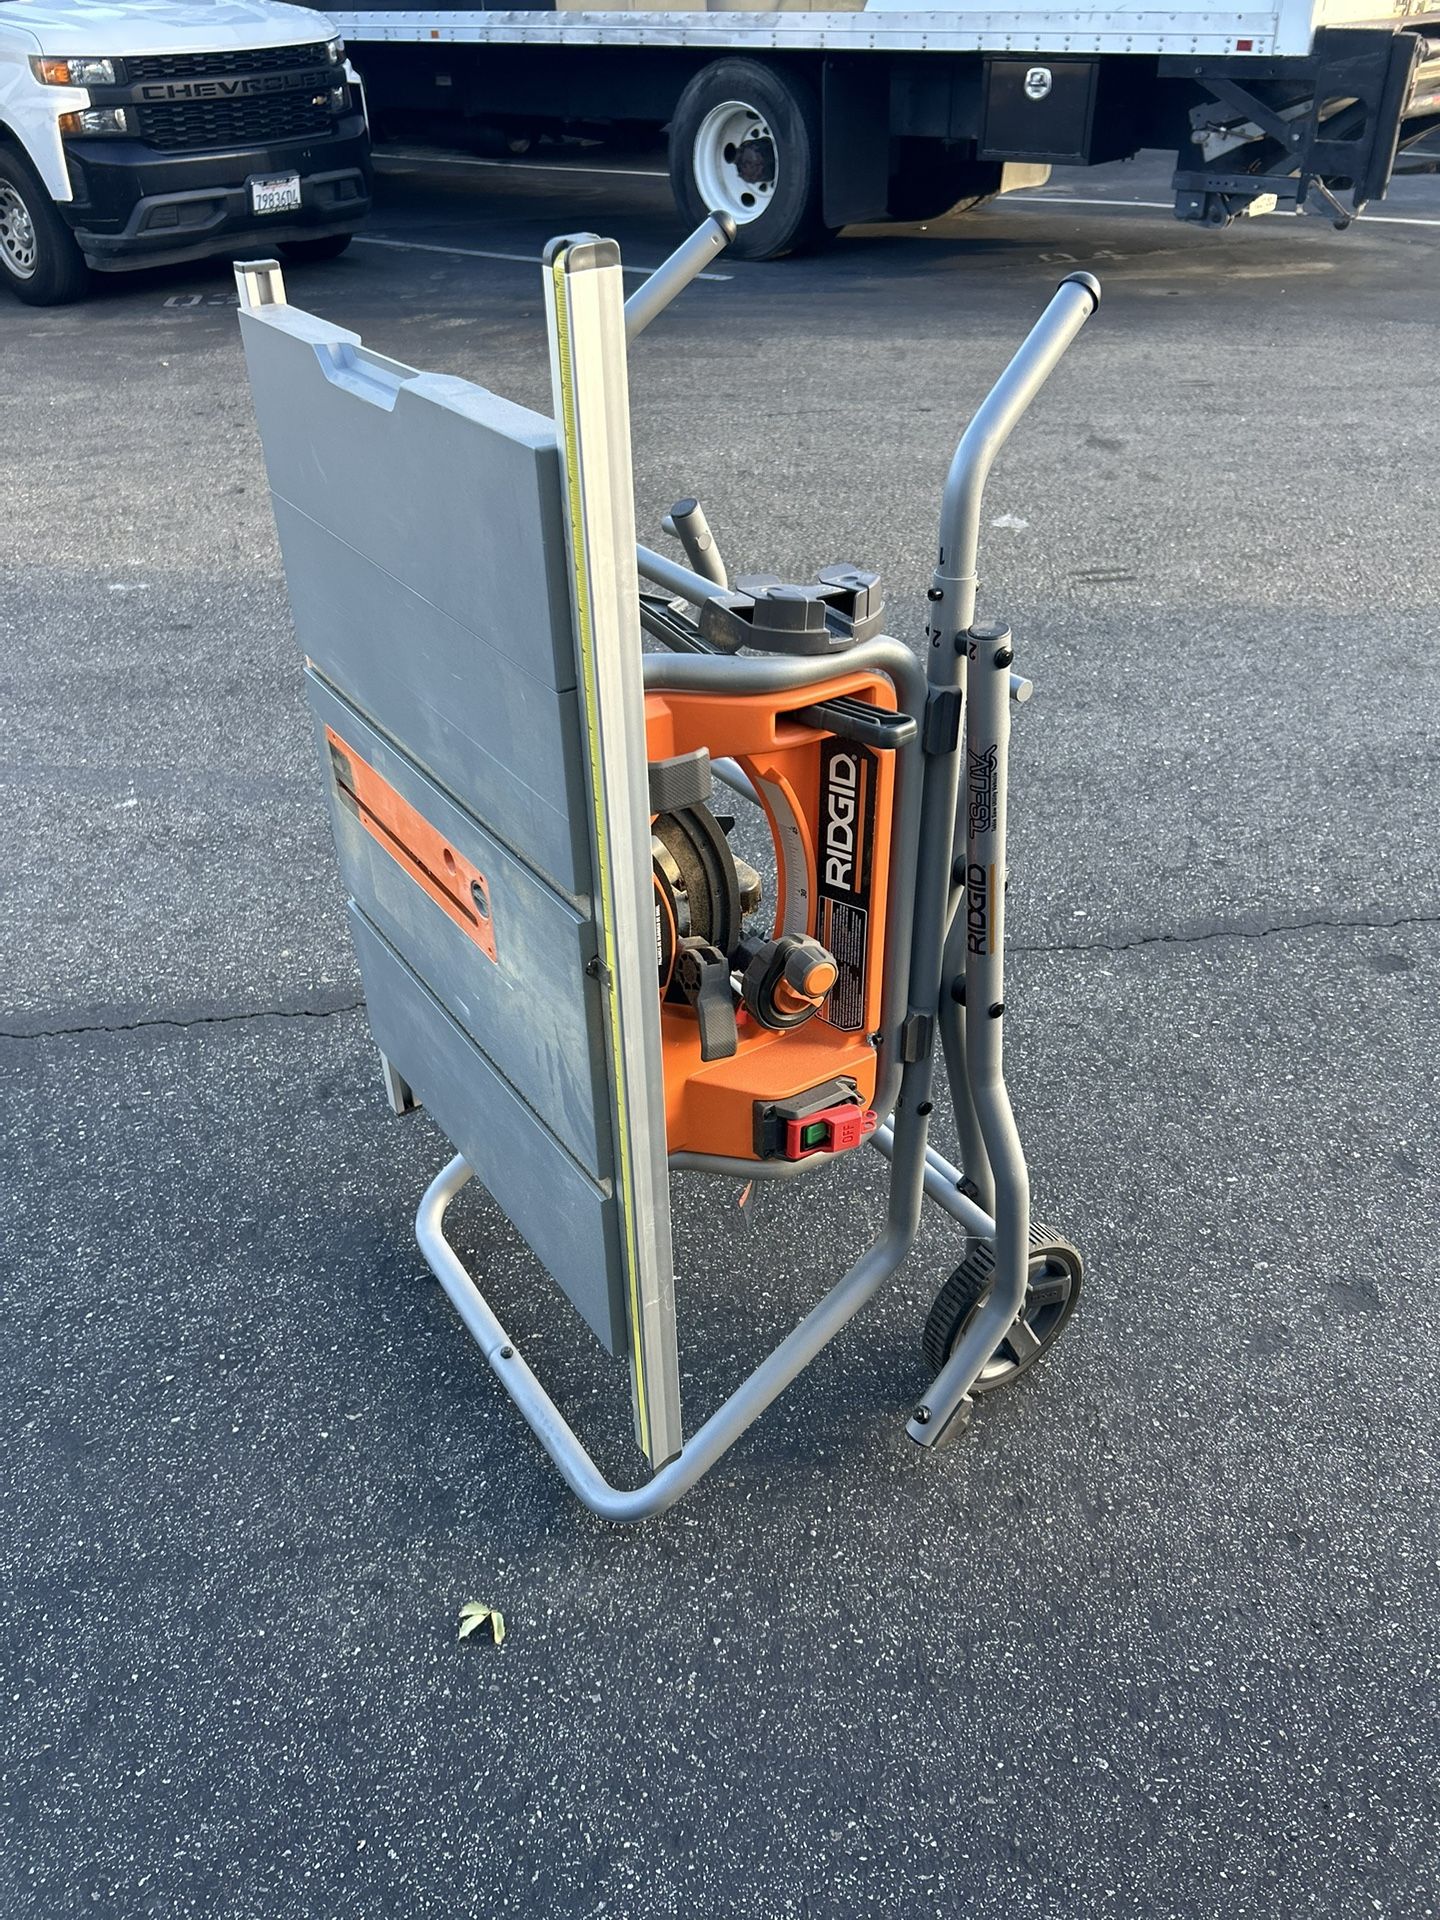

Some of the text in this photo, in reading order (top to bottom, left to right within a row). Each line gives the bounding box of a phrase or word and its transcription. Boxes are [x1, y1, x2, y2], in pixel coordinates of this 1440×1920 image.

[142, 71, 331, 100] CHEVROLET
[932, 629, 942, 648] 2
[968, 642, 978, 661] 2
[826, 752, 857, 891] RIDGID
[967, 863, 987, 956] RIDGID
[842, 1125, 855, 1144] OFF
